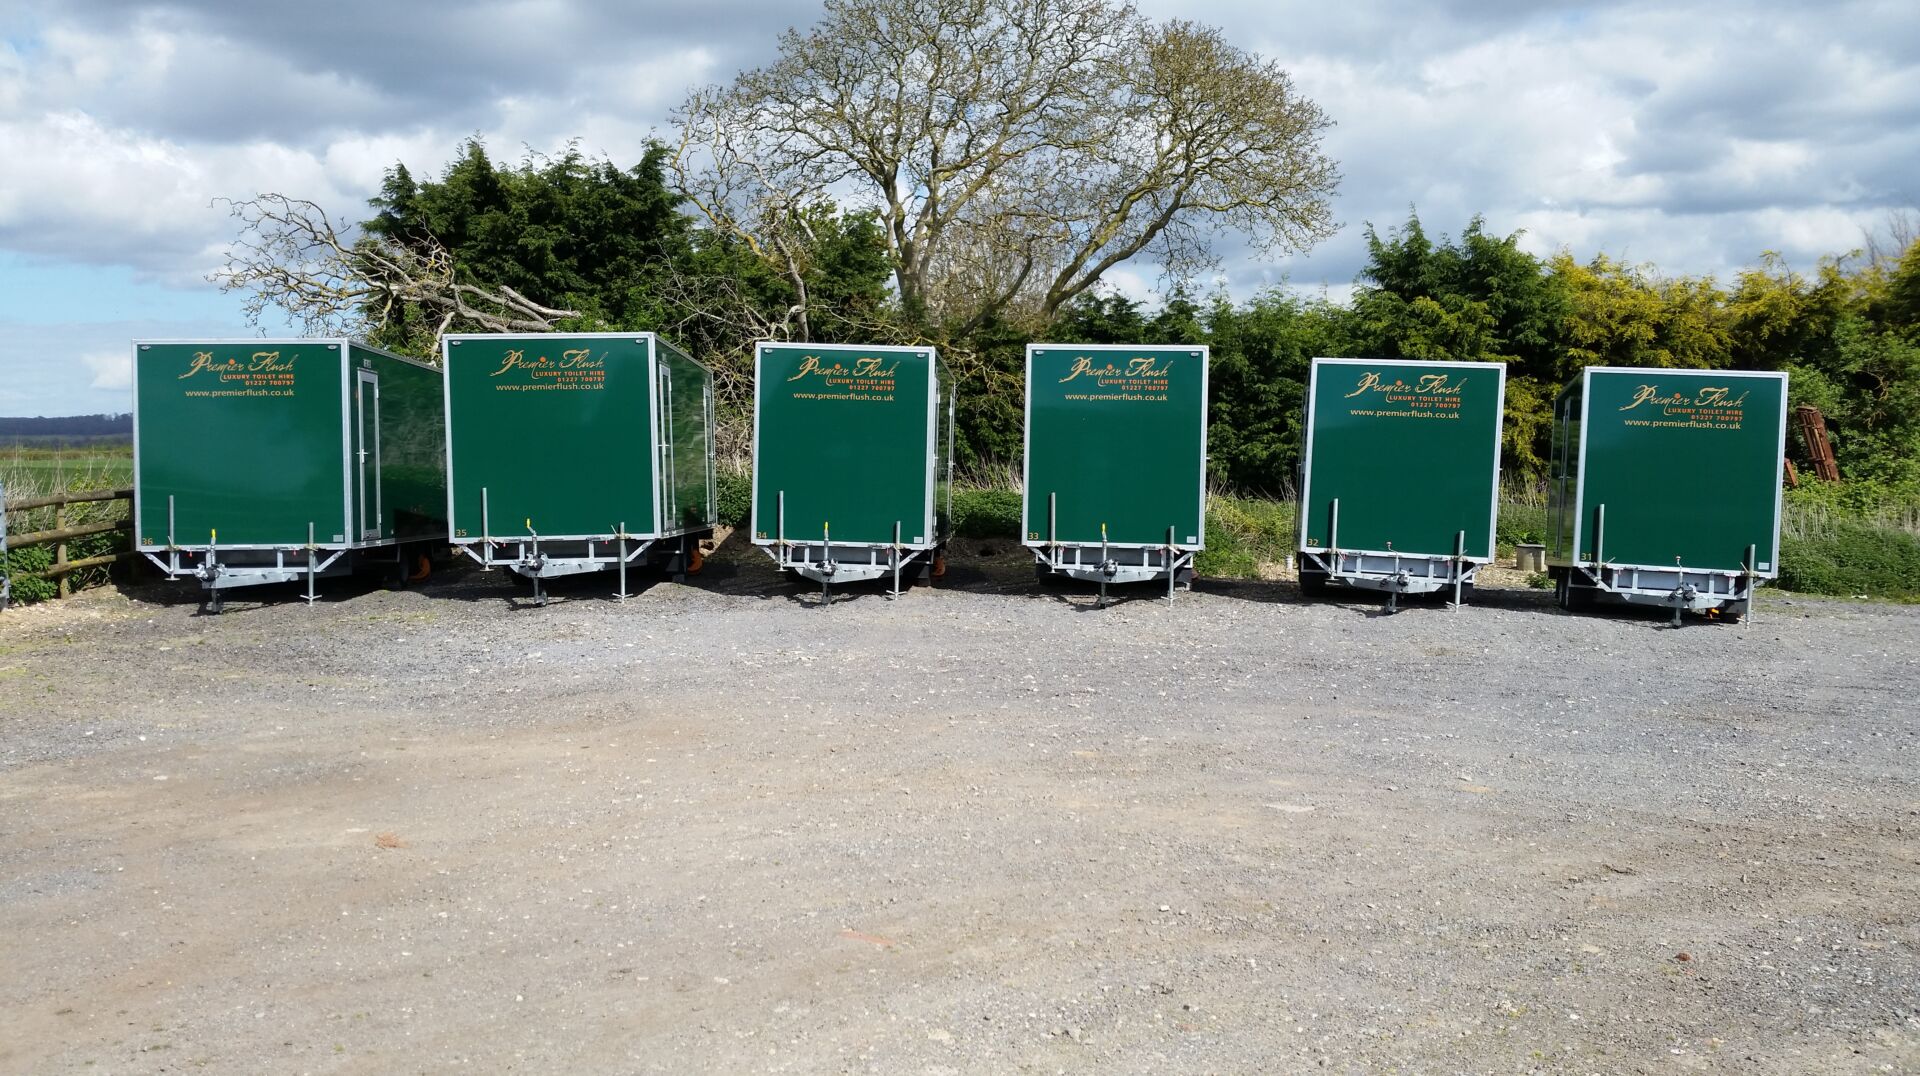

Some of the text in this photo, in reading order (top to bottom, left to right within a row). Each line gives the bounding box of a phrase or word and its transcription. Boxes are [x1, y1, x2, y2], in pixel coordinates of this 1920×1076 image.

[178, 351, 298, 382] Premier Flush
[490, 349, 608, 379] Premier Flush
[787, 355, 900, 386] Premier Flush
[1058, 356, 1173, 387] Premier Flush
[496, 383, 604, 392] www.premierflush.co.uk
[1344, 372, 1468, 403] Premier Flush
[185, 389, 294, 398] www.premierflush.co.uk
[793, 392, 894, 401] www.premierflush.co.uk
[1065, 393, 1168, 401] www.premierflush.co.uk
[1619, 384, 1750, 416] Premier Flush
[1350, 409, 1459, 419] www.premierflush.co.uk
[1624, 420, 1741, 430] www.premierflush.co.uk
[757, 531, 767, 539] 34
[1308, 538, 1318, 546] 32
